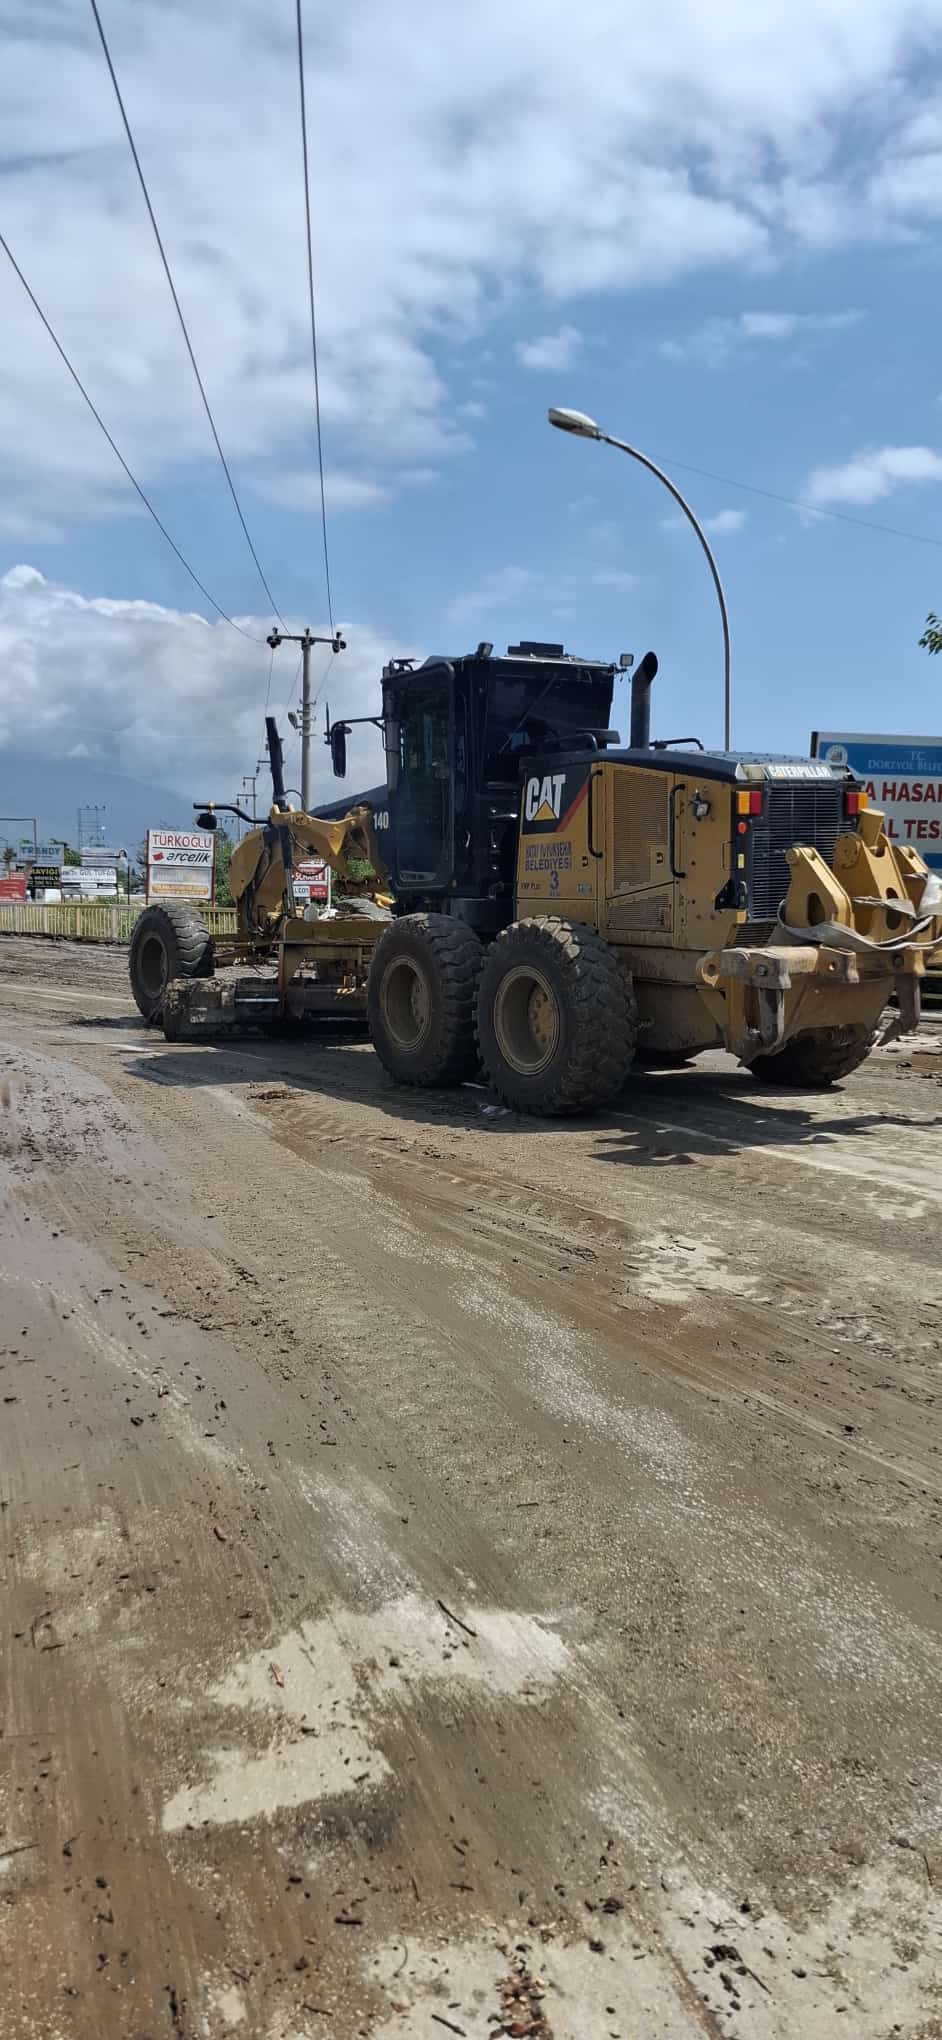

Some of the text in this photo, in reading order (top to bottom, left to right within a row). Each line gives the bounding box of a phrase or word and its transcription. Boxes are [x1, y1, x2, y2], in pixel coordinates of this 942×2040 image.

[767, 765, 833, 778] CATERPILLAR
[525, 773, 566, 822] CAT
[372, 811, 389, 830] 140
[903, 819, 942, 840] TES
[152, 831, 212, 849] TÜRKOĞLU
[549, 870, 559, 890] 3
